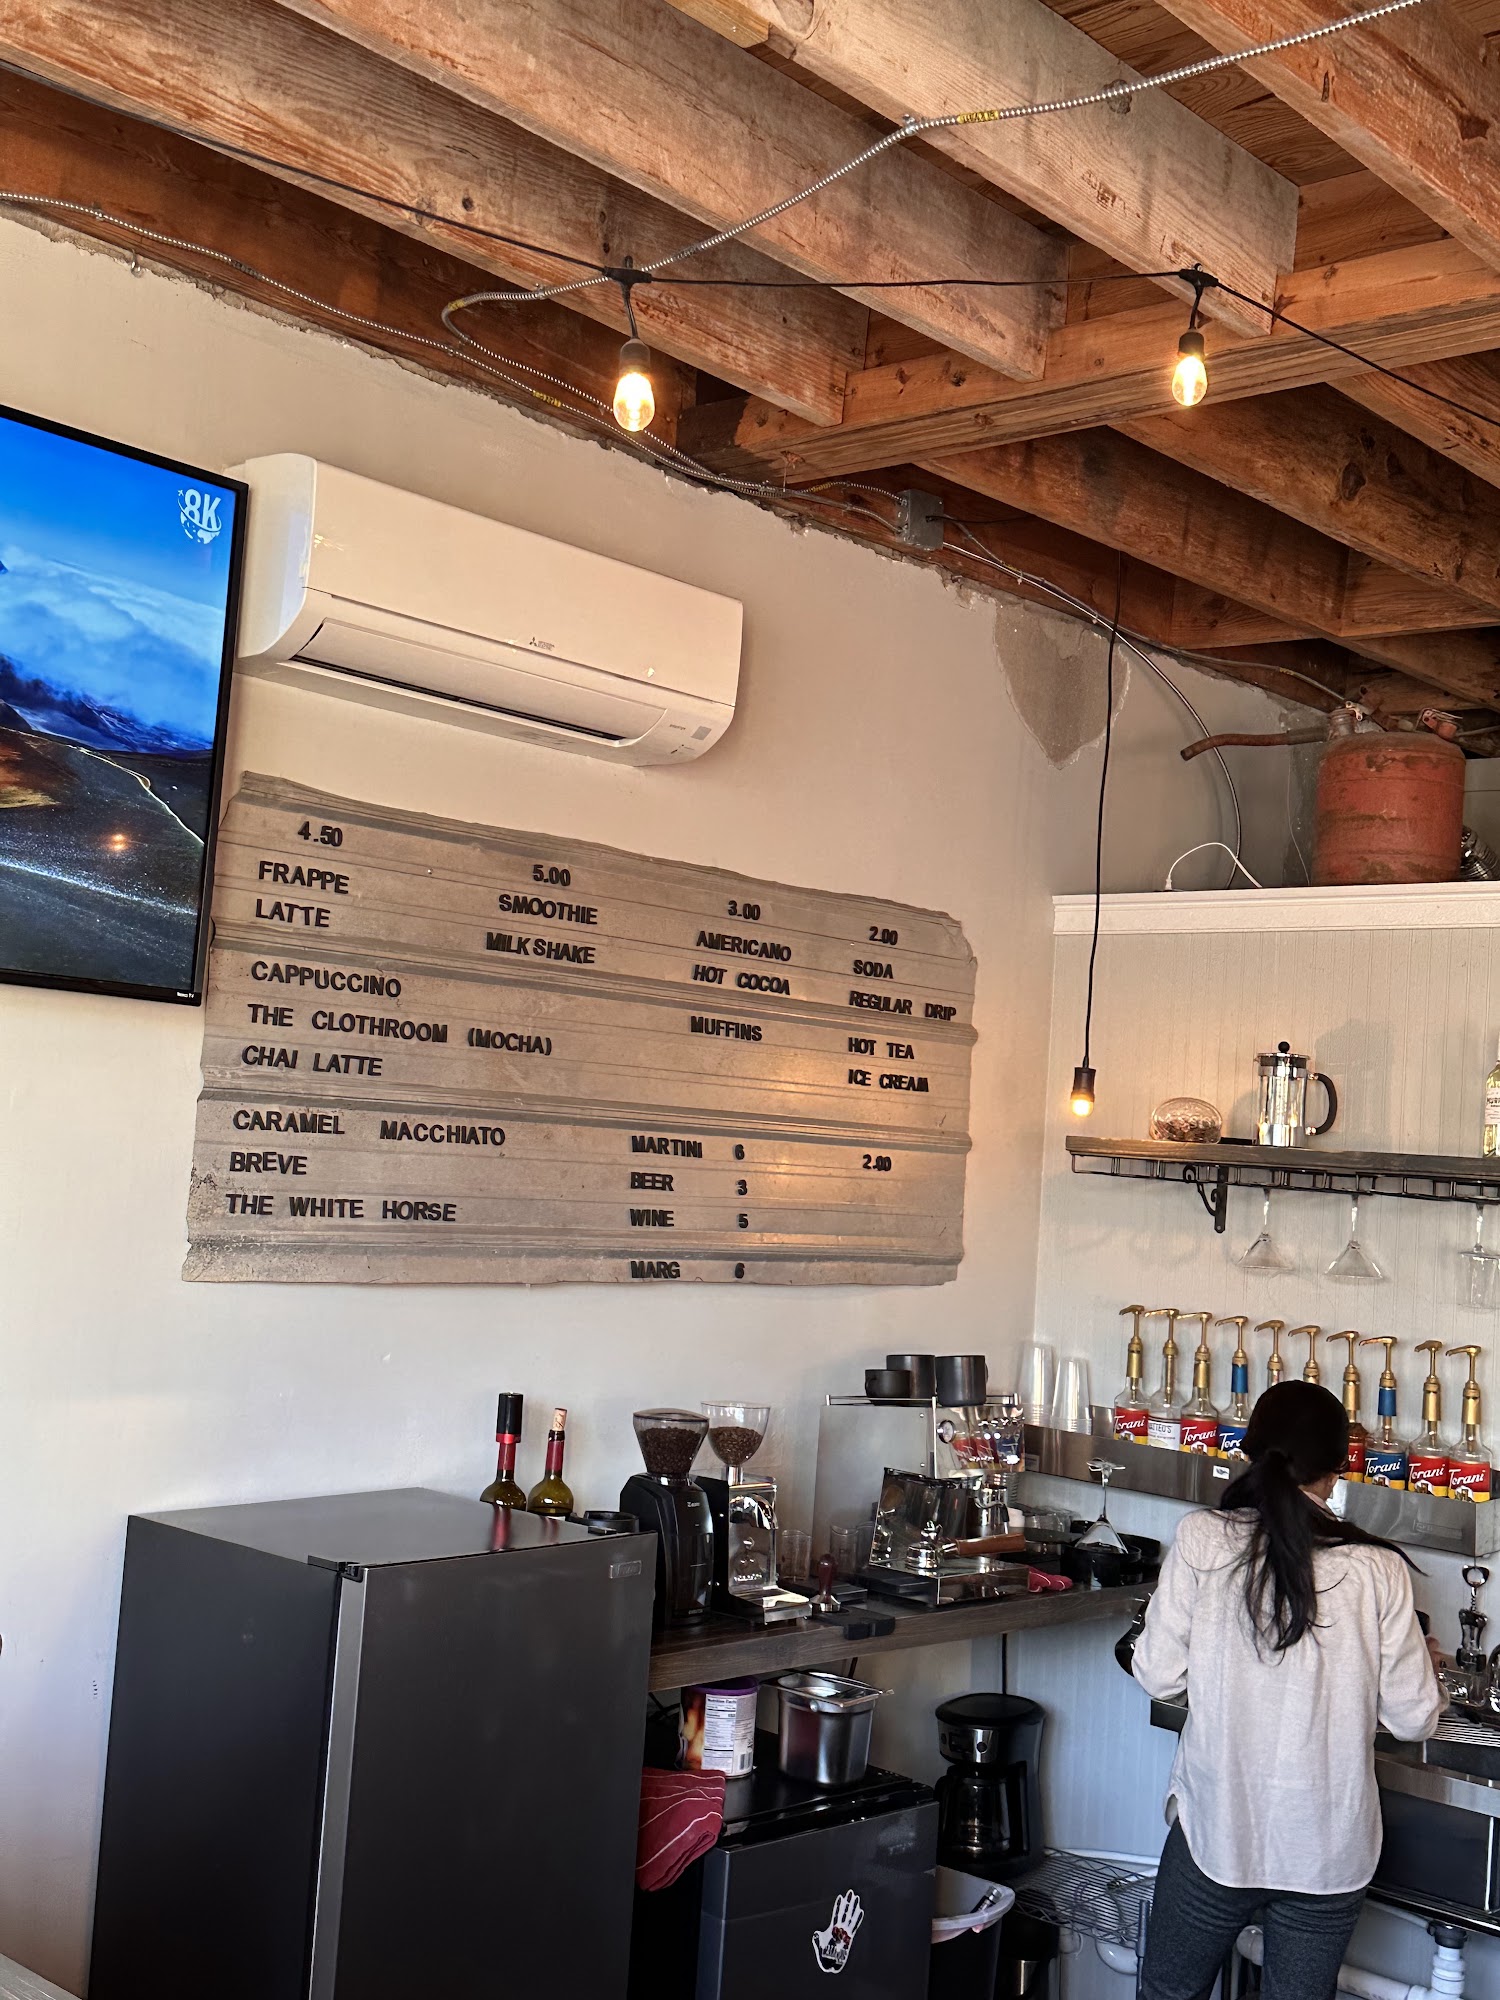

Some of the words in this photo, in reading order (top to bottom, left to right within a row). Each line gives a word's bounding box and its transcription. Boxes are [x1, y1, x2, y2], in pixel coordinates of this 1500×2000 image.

[185, 489, 221, 530] 8K
[298, 822, 342, 847] 4.50
[259, 860, 350, 895] FRAPPE
[533, 864, 571, 887] 5.00
[255, 899, 331, 928] LATTE
[499, 894, 598, 925] SMOOTHIE
[728, 900, 761, 921] 3.00
[486, 932, 596, 964] MILKSHAKE
[696, 930, 792, 962] AMERICANO
[869, 926, 898, 946] 2.00
[251, 960, 401, 998] CAPPUCCINO
[693, 964, 728, 985] HOT
[737, 972, 790, 995] COCOA
[853, 959, 894, 980] SODA
[849, 991, 913, 1015] REGULAR
[925, 1004, 957, 1021] DRIP
[247, 1003, 294, 1027] THE
[311, 1010, 448, 1043] CLOTHROOM
[467, 1027, 553, 1056] (MOCHA)
[690, 1016, 763, 1042] MUFFINS
[242, 1045, 298, 1070] CHAI
[312, 1052, 383, 1076] LATTE
[848, 1037, 877, 1056] HOT
[887, 1042, 915, 1060] TEA
[848, 1069, 872, 1087] ICE
[879, 1074, 930, 1093] CREAM
[232, 1109, 346, 1136] CARAMEL
[380, 1120, 506, 1146] MACCHIATO
[631, 1135, 703, 1158] MARTINI
[734, 1144, 745, 1160] 6
[229, 1151, 308, 1176] BREVE
[862, 1154, 892, 1172] 2.00
[630, 1172, 674, 1192] BEER
[737, 1179, 748, 1196] 3
[225, 1193, 274, 1216] THE
[289, 1196, 365, 1219] WHITE
[381, 1200, 457, 1222] HORSE
[629, 1209, 675, 1227] WINE
[738, 1213, 749, 1229] 5
[630, 1261, 681, 1279] MARG
[734, 1262, 745, 1279] 6
[1114, 1415, 1146, 1434] Torani
[1182, 1426, 1218, 1446] Torani
[1219, 1432, 1243, 1452] Tora
[1365, 1458, 1402, 1479] Torani
[1408, 1463, 1446, 1483] Torani
[1449, 1469, 1486, 1490] Torani
